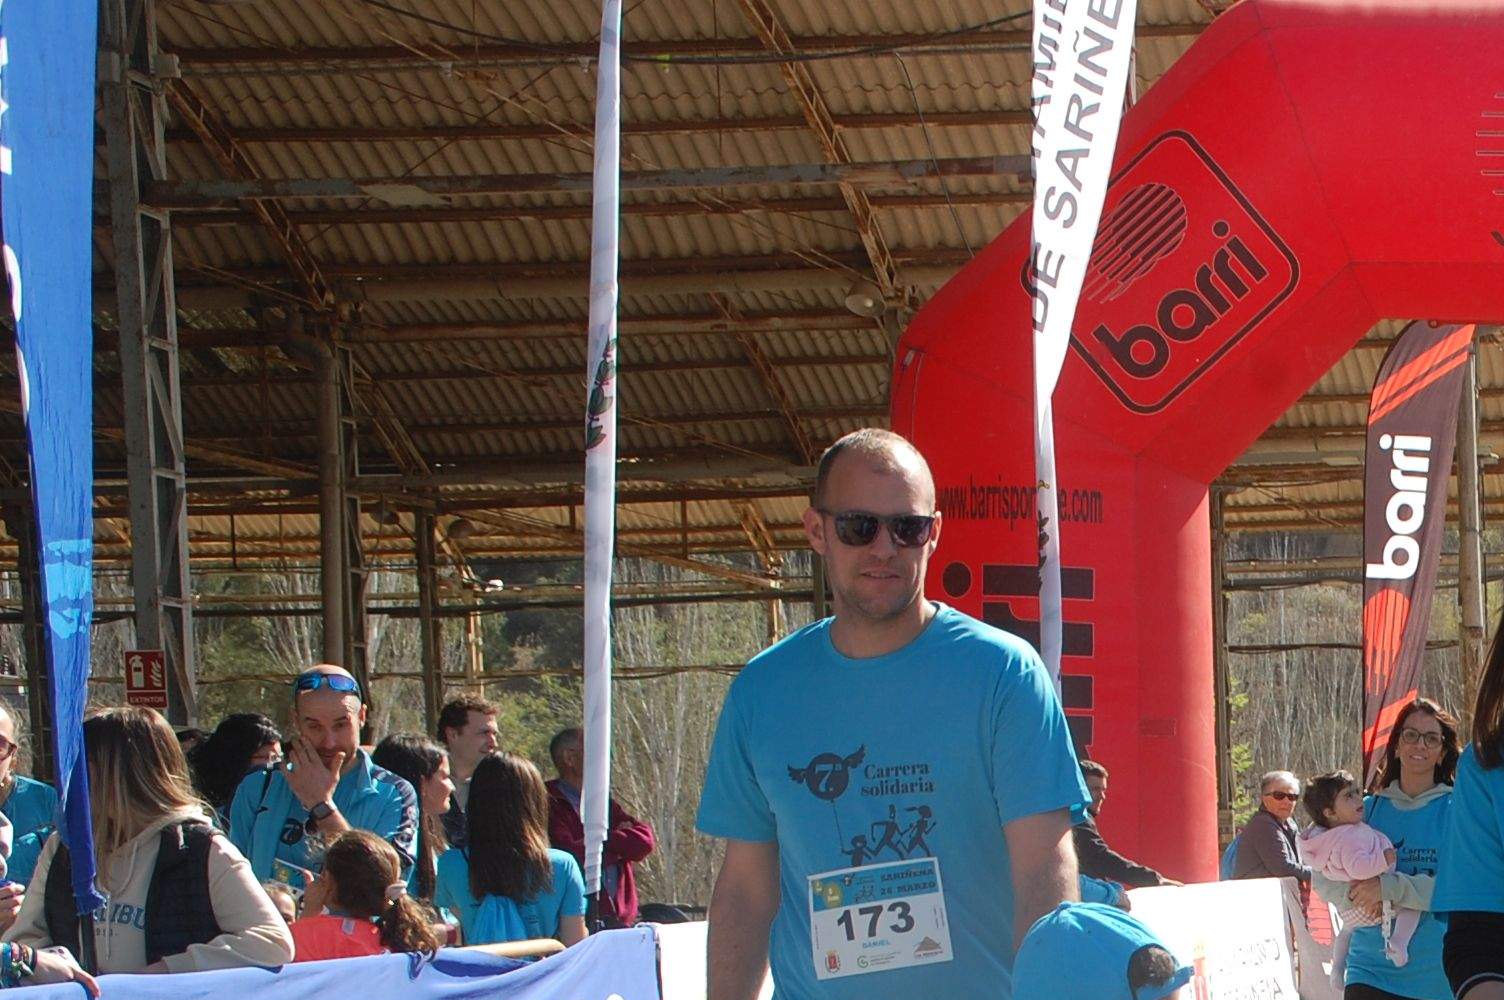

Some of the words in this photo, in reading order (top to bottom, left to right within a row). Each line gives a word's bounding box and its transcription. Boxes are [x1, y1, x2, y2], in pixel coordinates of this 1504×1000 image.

[1031, 241, 1066, 334] DE
[1093, 219, 1269, 379] barri
[1366, 433, 1432, 579] barri
[860, 777, 934, 797] solidaria
[864, 763, 929, 780] Carrera
[897, 881, 936, 893] MARZO
[837, 901, 915, 941] 173
